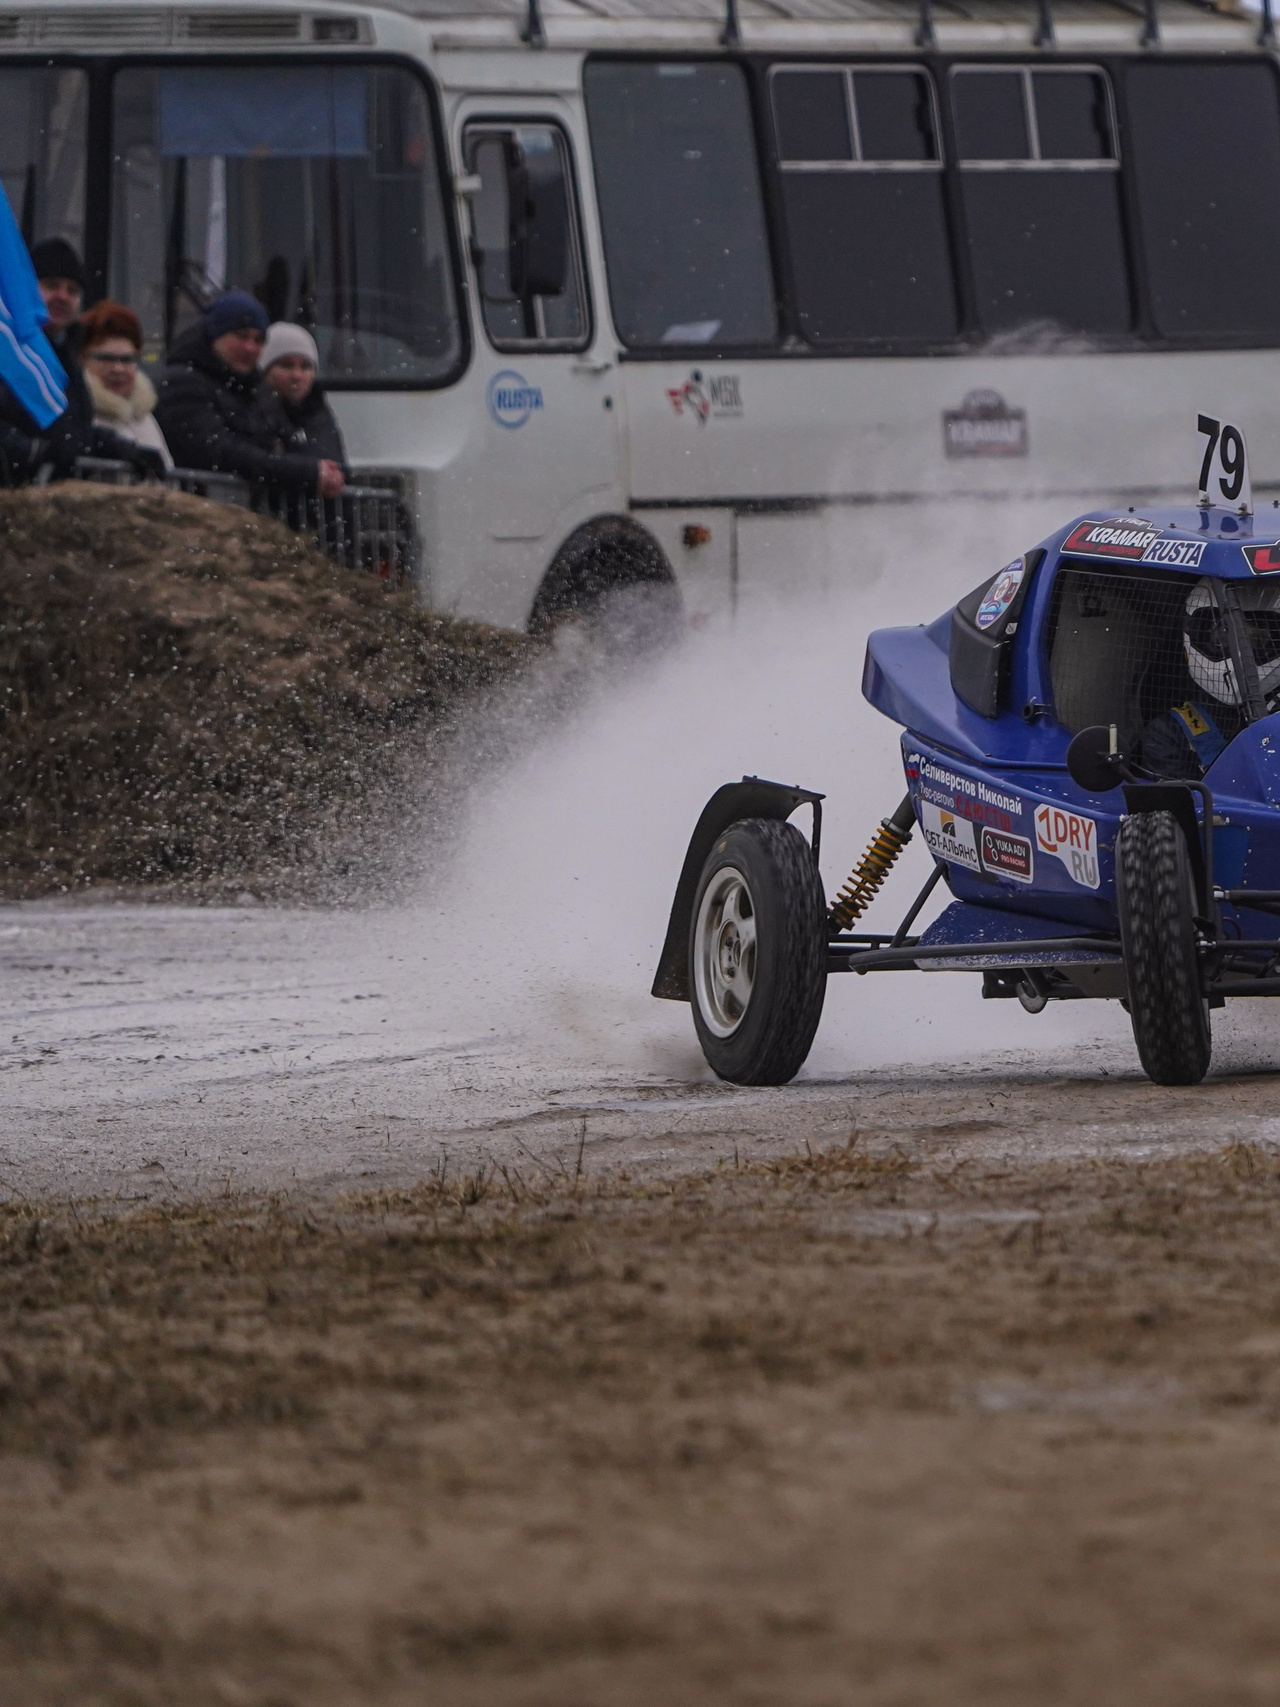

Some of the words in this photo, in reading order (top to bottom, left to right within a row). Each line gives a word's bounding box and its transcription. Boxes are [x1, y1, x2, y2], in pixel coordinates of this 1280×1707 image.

[497, 387, 544, 411] RUSTA
[1197, 413, 1245, 500] 79
[1085, 526, 1156, 548] KRAMAR
[1144, 540, 1203, 565] RUSTA
[919, 756, 976, 797] Селиверстов
[977, 781, 1023, 816] Николай
[1037, 806, 1094, 852] 1DRY
[925, 829, 978, 863] СБТ-АЛЬЯНС
[994, 838, 1014, 854] YUKA
[1000, 854, 1010, 863] PRO
[1010, 857, 1026, 868] RACING
[1070, 850, 1097, 886] RU
